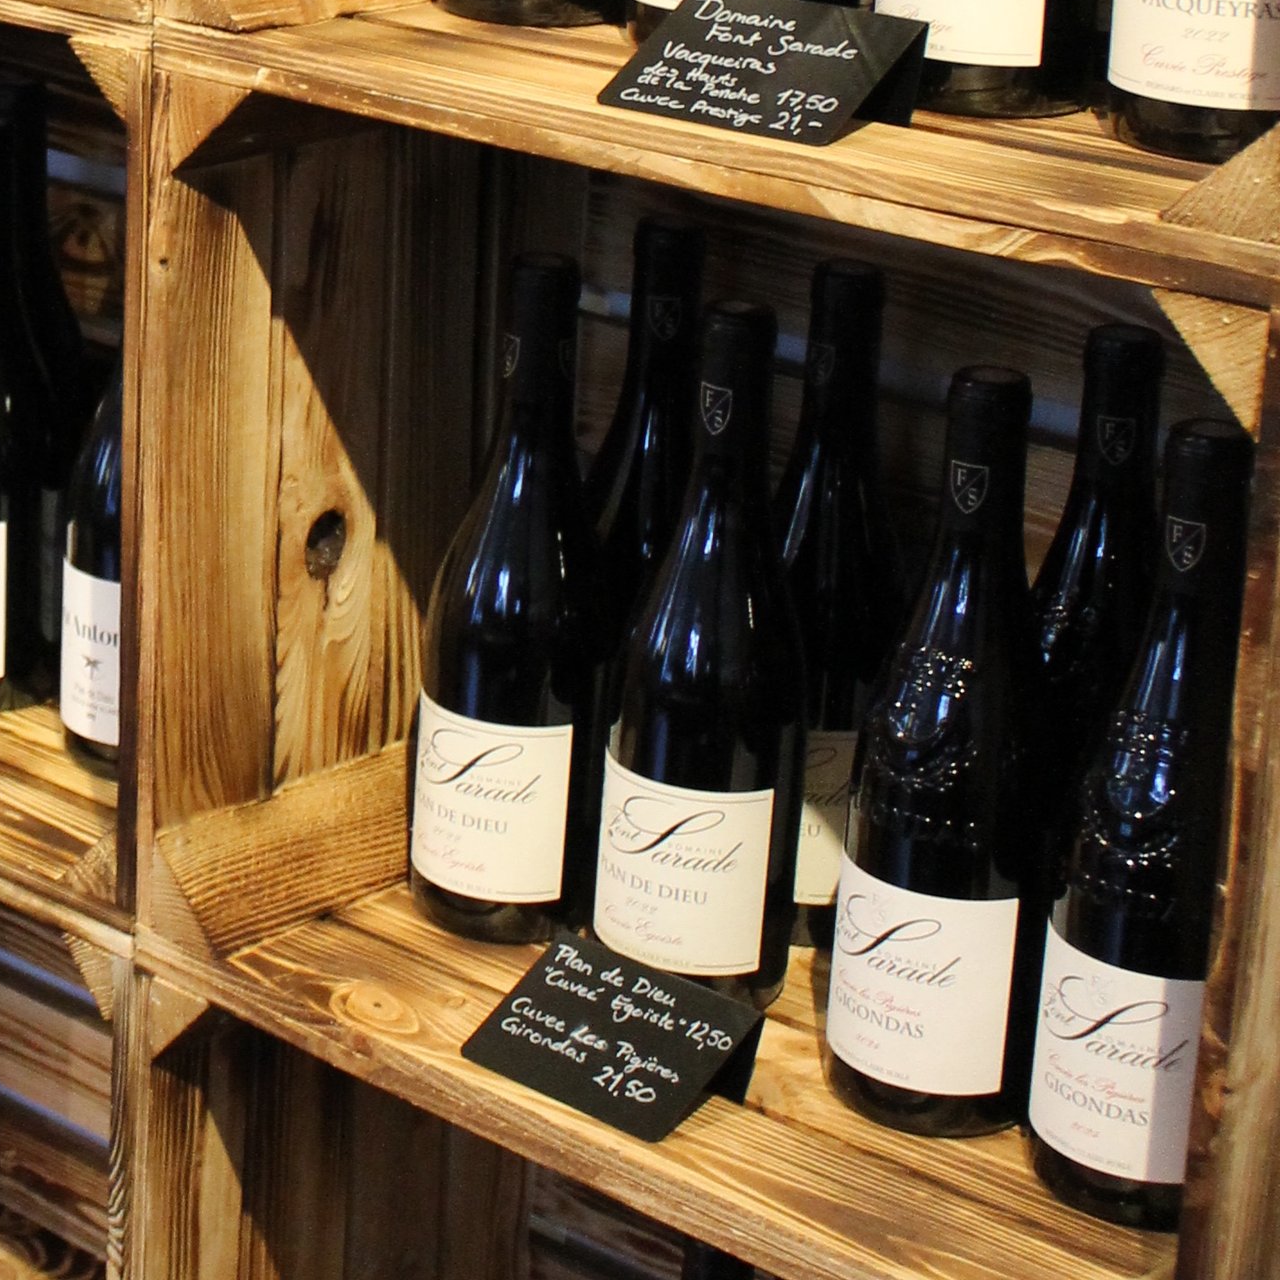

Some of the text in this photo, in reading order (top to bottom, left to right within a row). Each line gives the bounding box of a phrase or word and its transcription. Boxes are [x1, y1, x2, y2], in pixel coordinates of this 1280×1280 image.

[704, 22, 859, 61] Font Sarade
[685, 66, 739, 87] Hauts
[775, 87, 839, 114] 17,50
[436, 804, 458, 825] DE
[461, 812, 509, 835] DIEU
[629, 873, 653, 896] DE
[658, 883, 709, 905] DIEU
[553, 942, 594, 977] Plan
[600, 966, 624, 988] de
[631, 976, 678, 1008] Dieu
[835, 984, 925, 1040] GIGONDAS
[685, 1020, 734, 1052] 12,50
[1044, 1071, 1150, 1127] GIGONDAS
